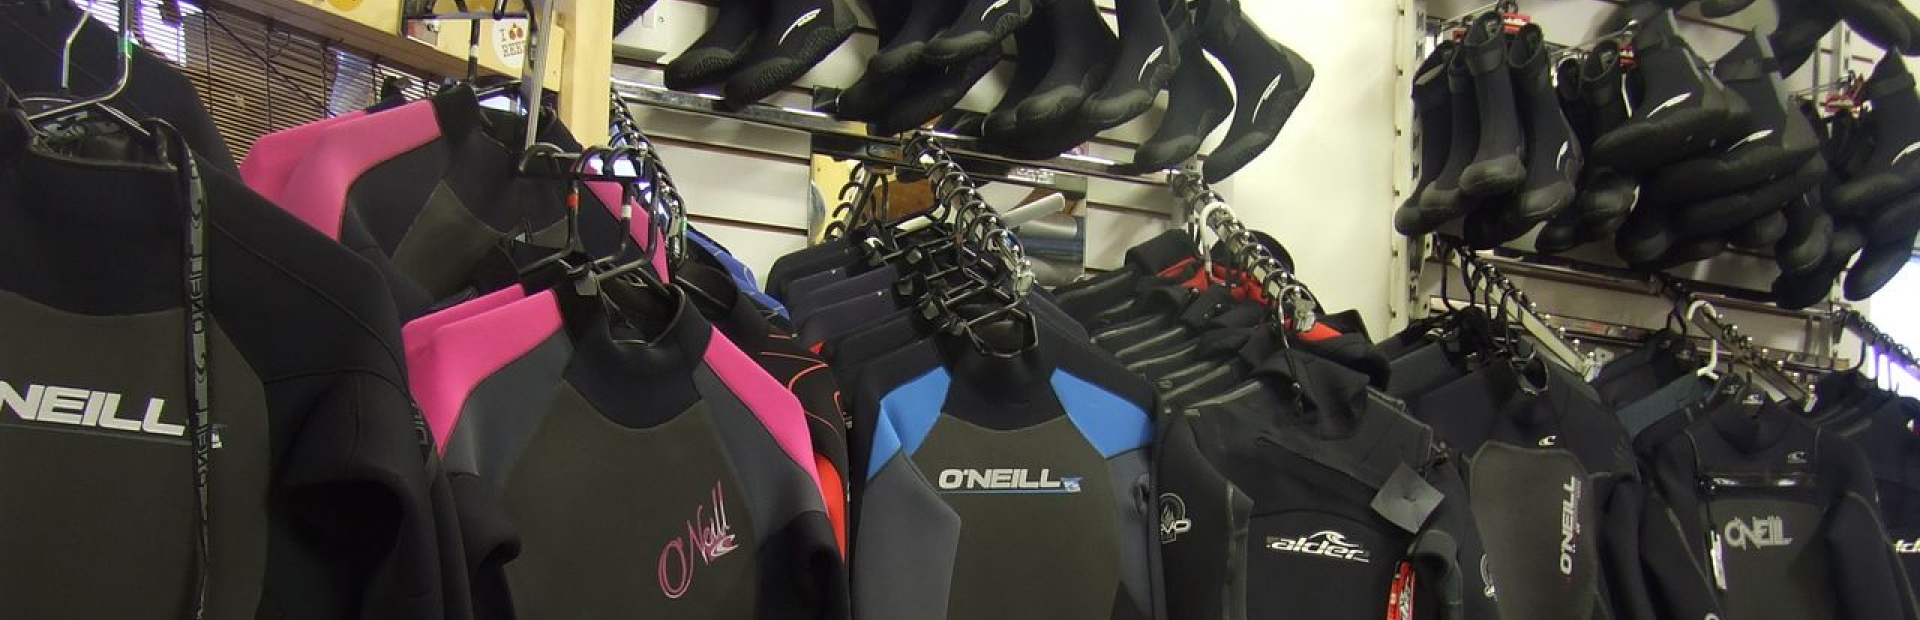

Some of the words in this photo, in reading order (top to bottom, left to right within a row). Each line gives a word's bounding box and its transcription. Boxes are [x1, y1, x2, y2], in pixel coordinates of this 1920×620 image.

[502, 40, 526, 57] REE
[938, 467, 1061, 490] O'NEILL
[1559, 475, 1575, 576] O'NEILL
[1270, 534, 1366, 562] alder
